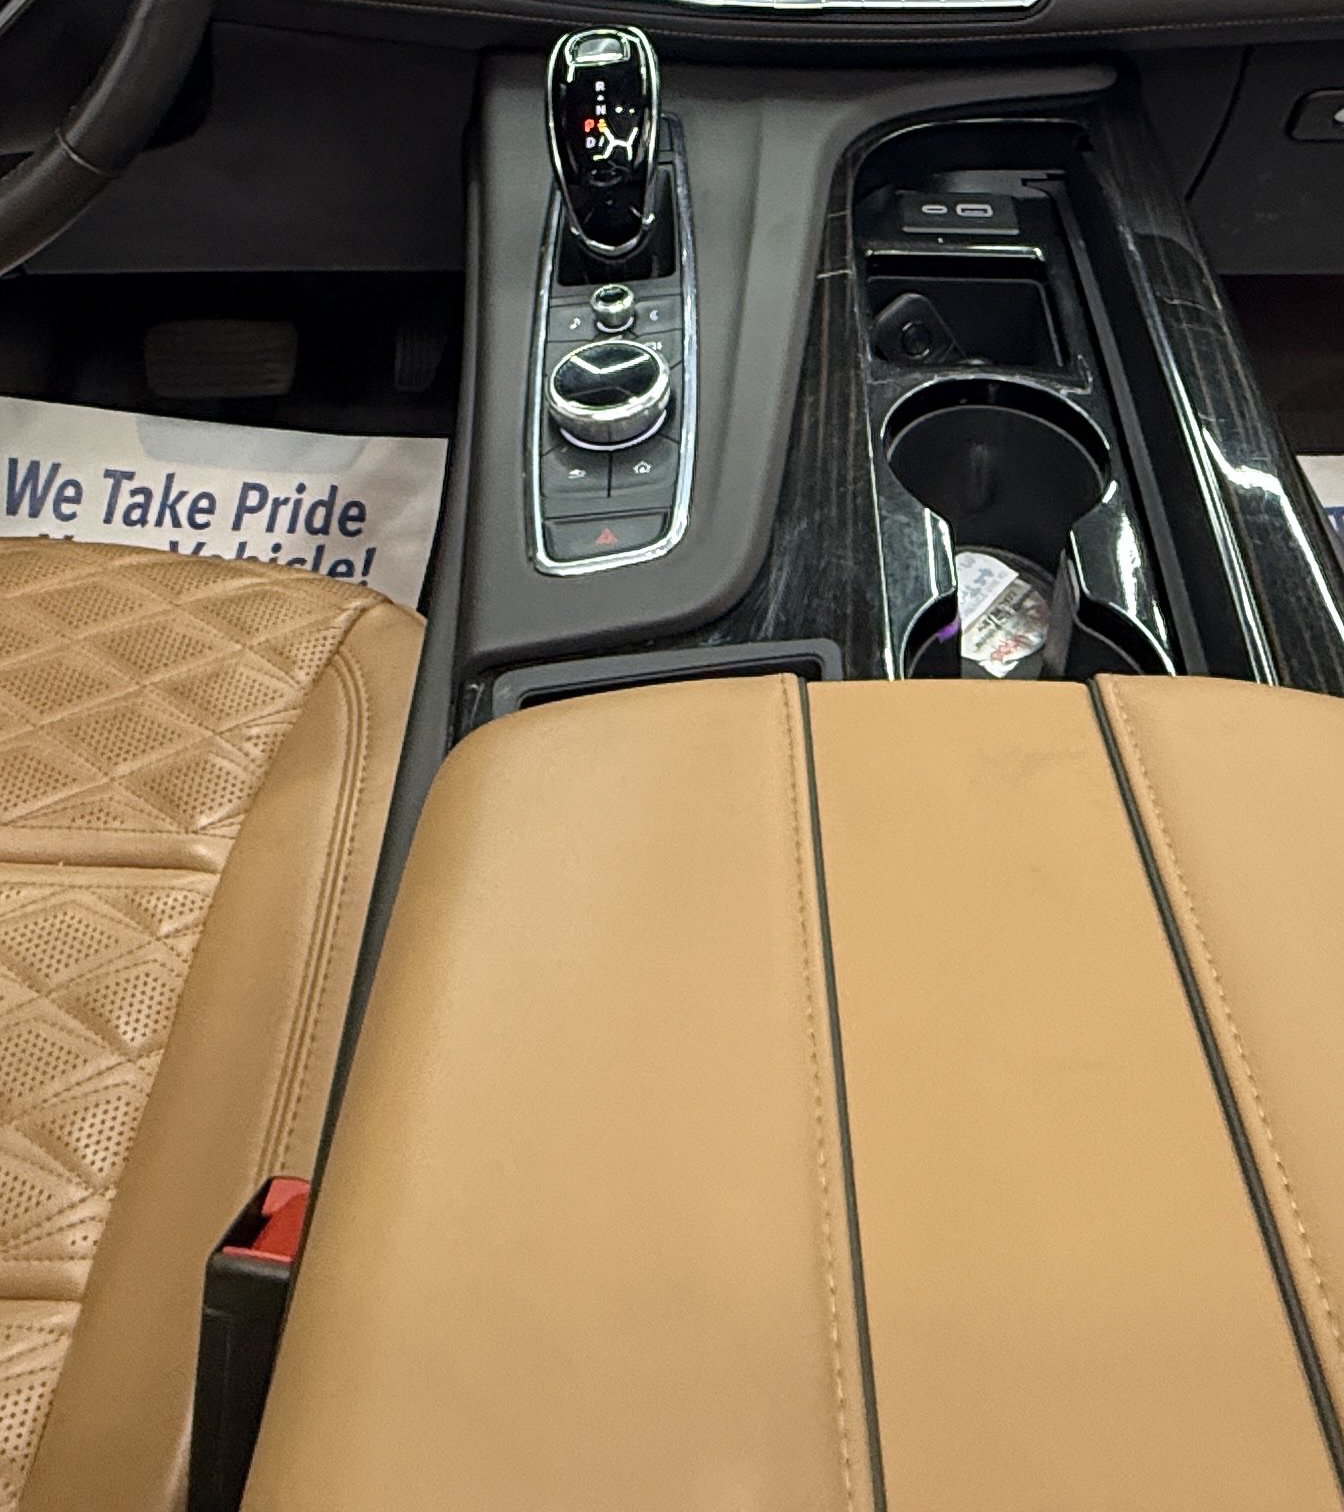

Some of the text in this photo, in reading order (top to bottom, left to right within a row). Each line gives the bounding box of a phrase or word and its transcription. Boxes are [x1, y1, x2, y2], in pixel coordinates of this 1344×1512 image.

[595, 104, 607, 116] N
[6, 456, 368, 538] We Take Pride
